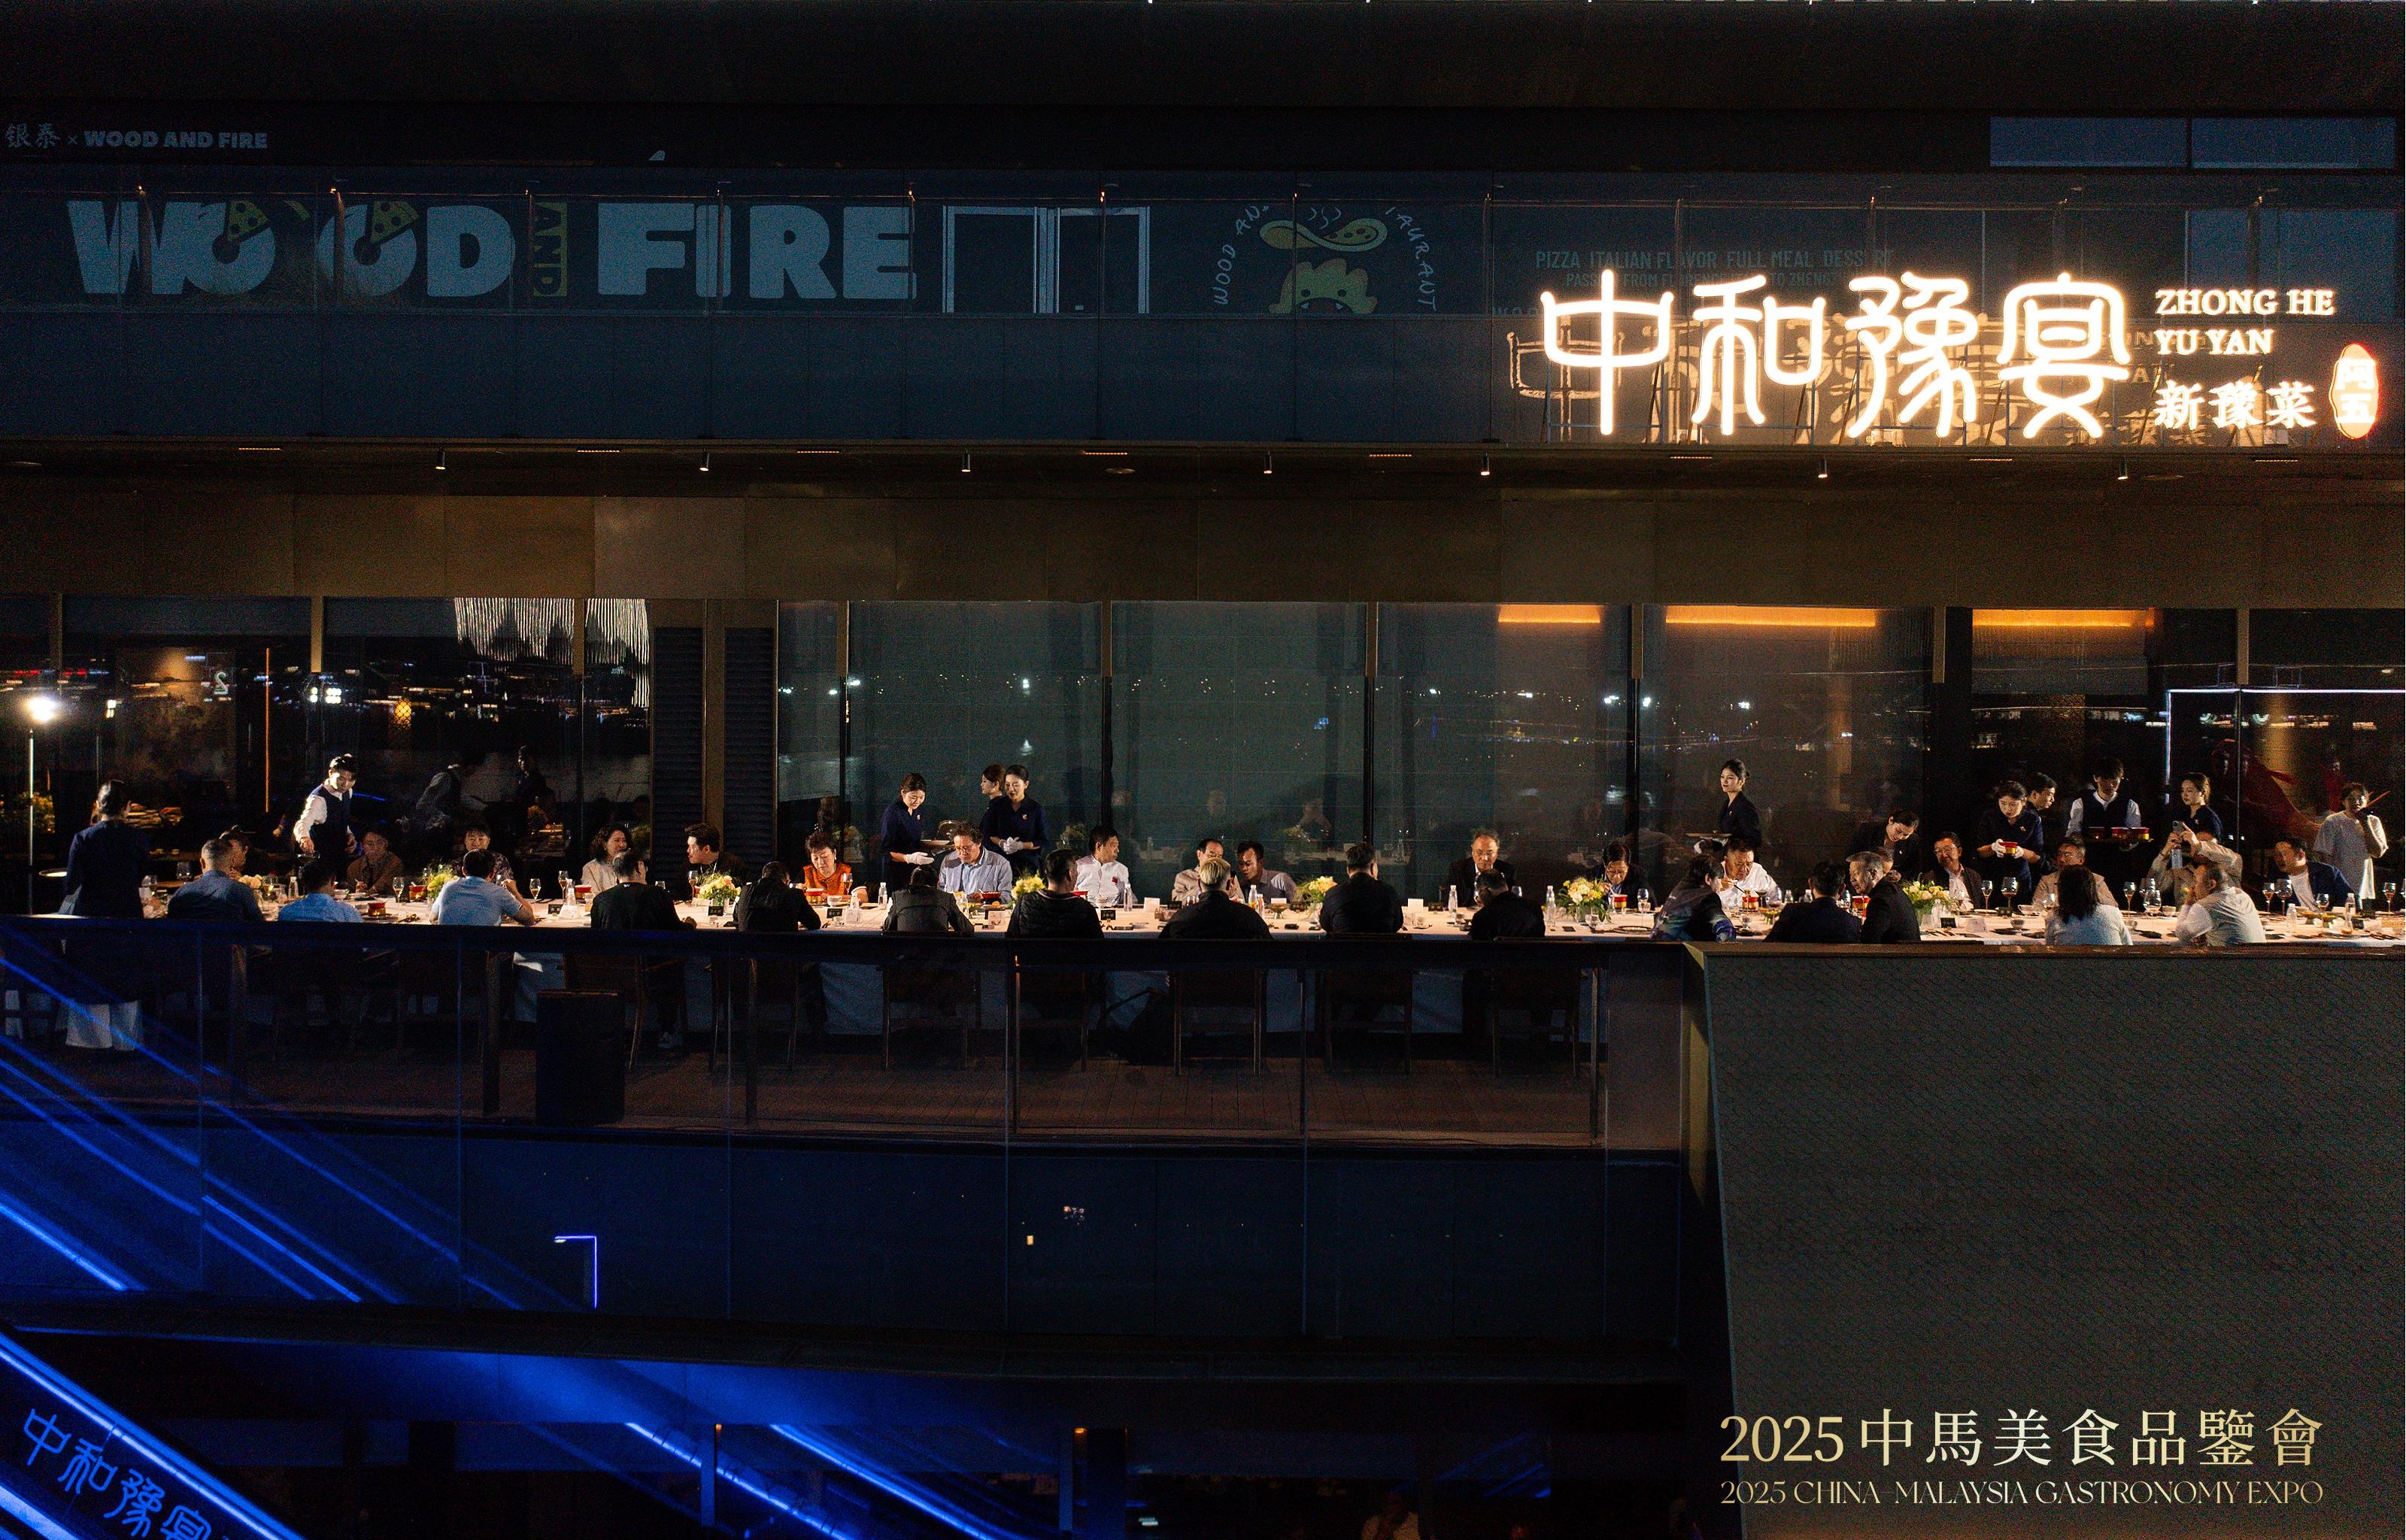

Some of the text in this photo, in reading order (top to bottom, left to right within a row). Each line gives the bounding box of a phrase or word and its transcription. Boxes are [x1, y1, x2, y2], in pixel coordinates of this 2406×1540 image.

[84, 131, 159, 148] WOOD
[163, 132, 214, 148] AND
[218, 132, 268, 149] FIRE
[66, 199, 917, 299] WOOD AND FIRE
[1536, 250, 1581, 269] PIZZA
[1589, 250, 1652, 269] ITALIAN
[1727, 250, 1767, 268] FULL
[1770, 250, 1815, 268] MEAL
[1823, 249, 1895, 268] DESSRT
[1212, 243, 1236, 305] WOOD
[1623, 273, 1658, 287] FROM
[1770, 272, 1786, 287] TO
[2155, 289, 2335, 316] ZHONG HE
[1540, 268, 2131, 438] 中和豫宴
[2153, 329, 2274, 355] YU YAN
[2153, 379, 2317, 430] 新豫菜
